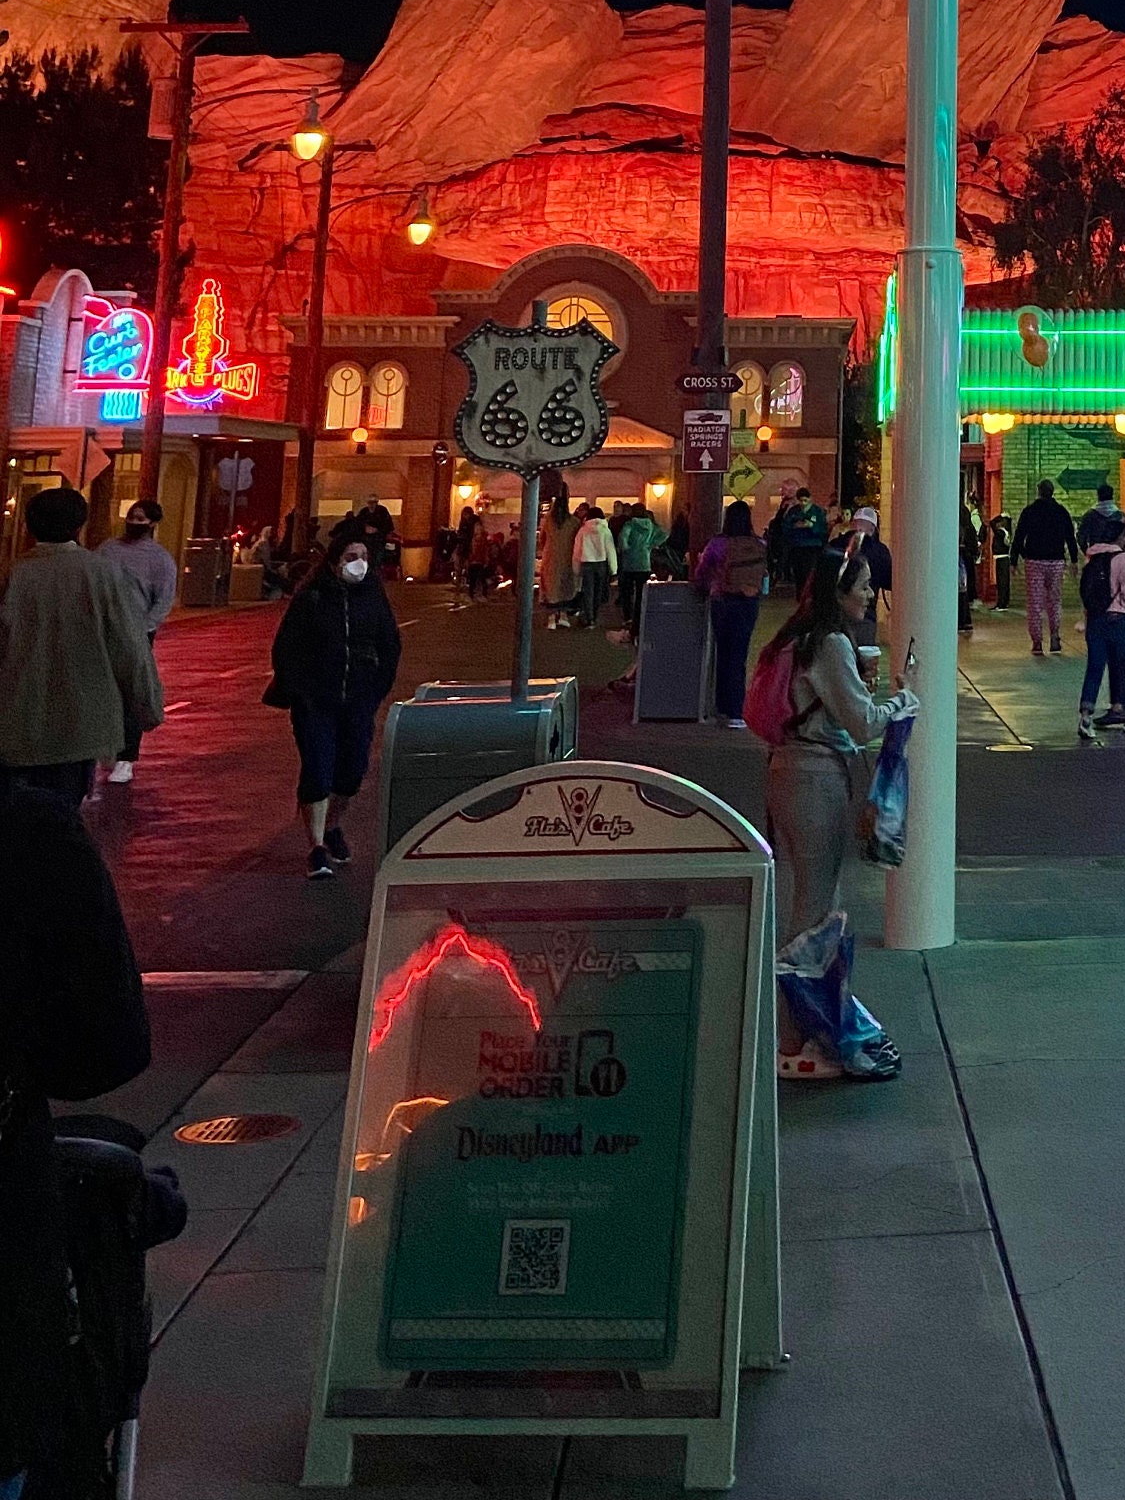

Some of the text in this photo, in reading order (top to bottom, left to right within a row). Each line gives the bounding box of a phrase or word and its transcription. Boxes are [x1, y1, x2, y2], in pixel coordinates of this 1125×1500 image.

[88, 322, 139, 355] Curb
[82, 342, 144, 378] Feeler
[494, 347, 579, 371] ROUTE
[213, 367, 253, 393] PLUGS
[683, 376, 735, 388] CROSS ST.
[479, 377, 586, 449] 66
[690, 440, 722, 448] RACERS
[587, 813, 635, 841] Cafe
[477, 1050, 571, 1073] MOBILE
[479, 1076, 564, 1099] ORDER
[455, 1123, 583, 1163] Disneyland
